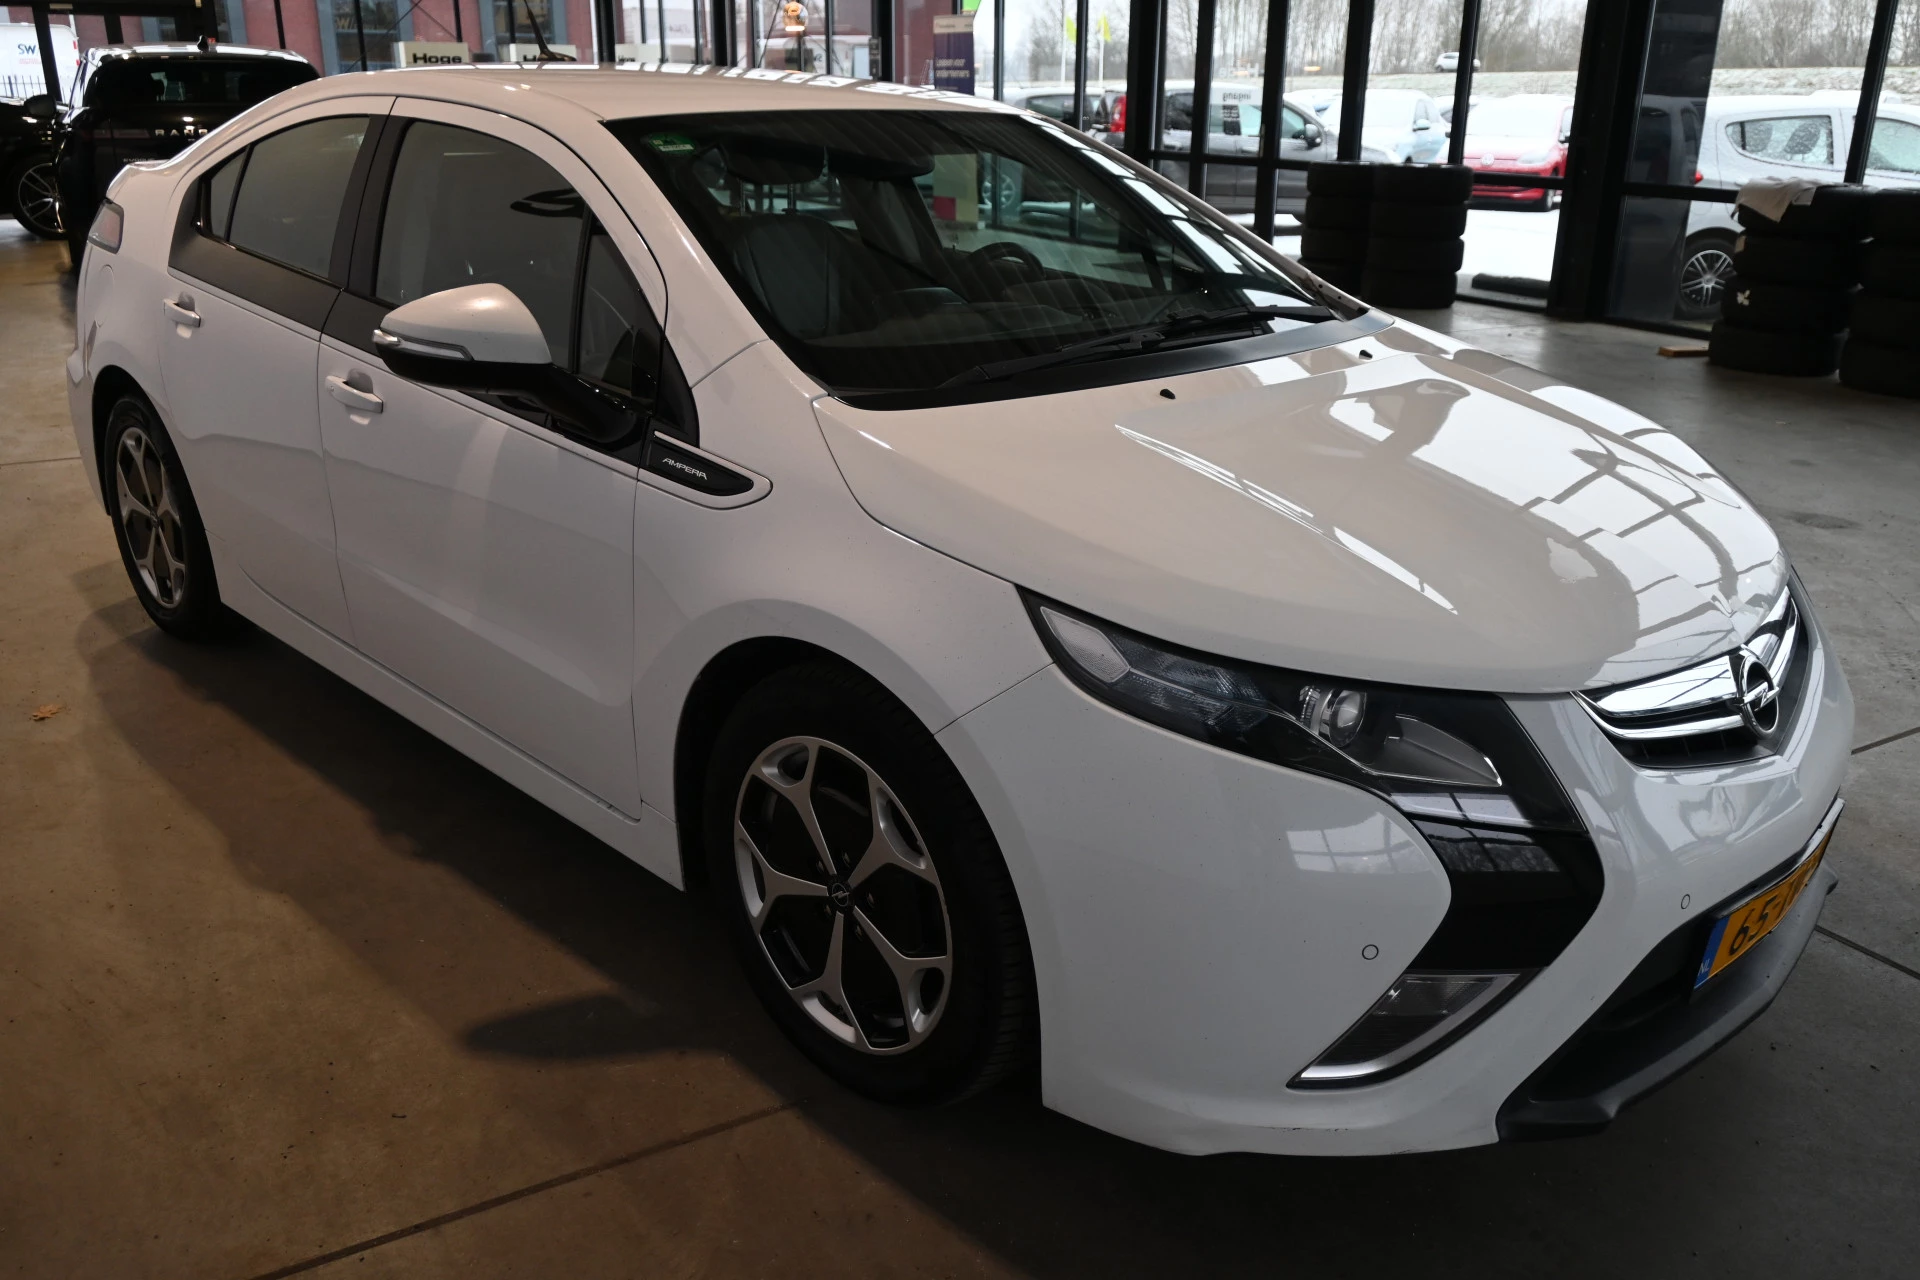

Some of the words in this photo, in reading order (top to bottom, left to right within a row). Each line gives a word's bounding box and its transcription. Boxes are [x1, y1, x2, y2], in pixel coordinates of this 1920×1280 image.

[412, 52, 462, 64] Hoge
[662, 457, 708, 480] AMPERA
[1698, 959, 1711, 975] NL
